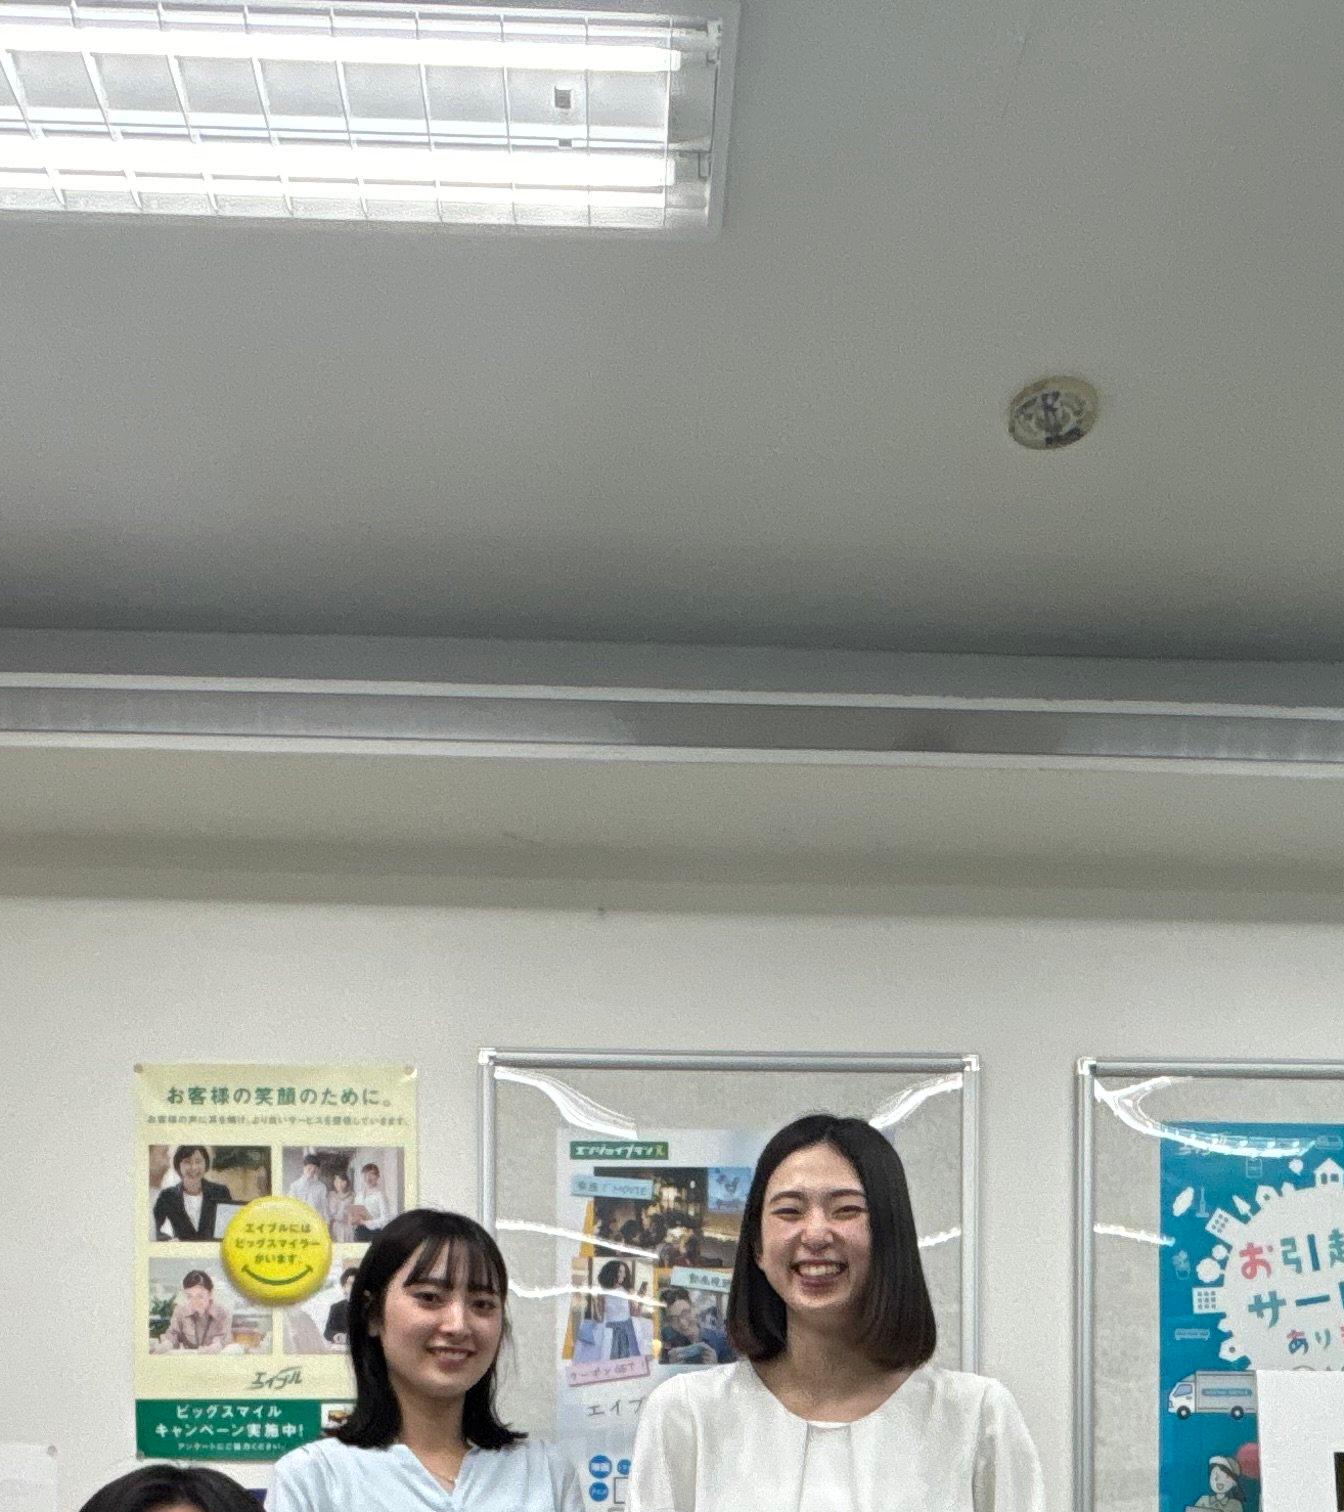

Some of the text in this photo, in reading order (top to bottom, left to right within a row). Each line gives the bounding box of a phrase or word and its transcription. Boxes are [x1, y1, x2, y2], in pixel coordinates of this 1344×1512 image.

[167, 1086, 392, 1107] お客様の笑顔のために。
[245, 1222, 311, 1234] エイブルには
[246, 1366, 304, 1390] エイブル
[176, 1404, 282, 1419] ビッグスマイル
[155, 1423, 304, 1438] キャンペーン実施中!
